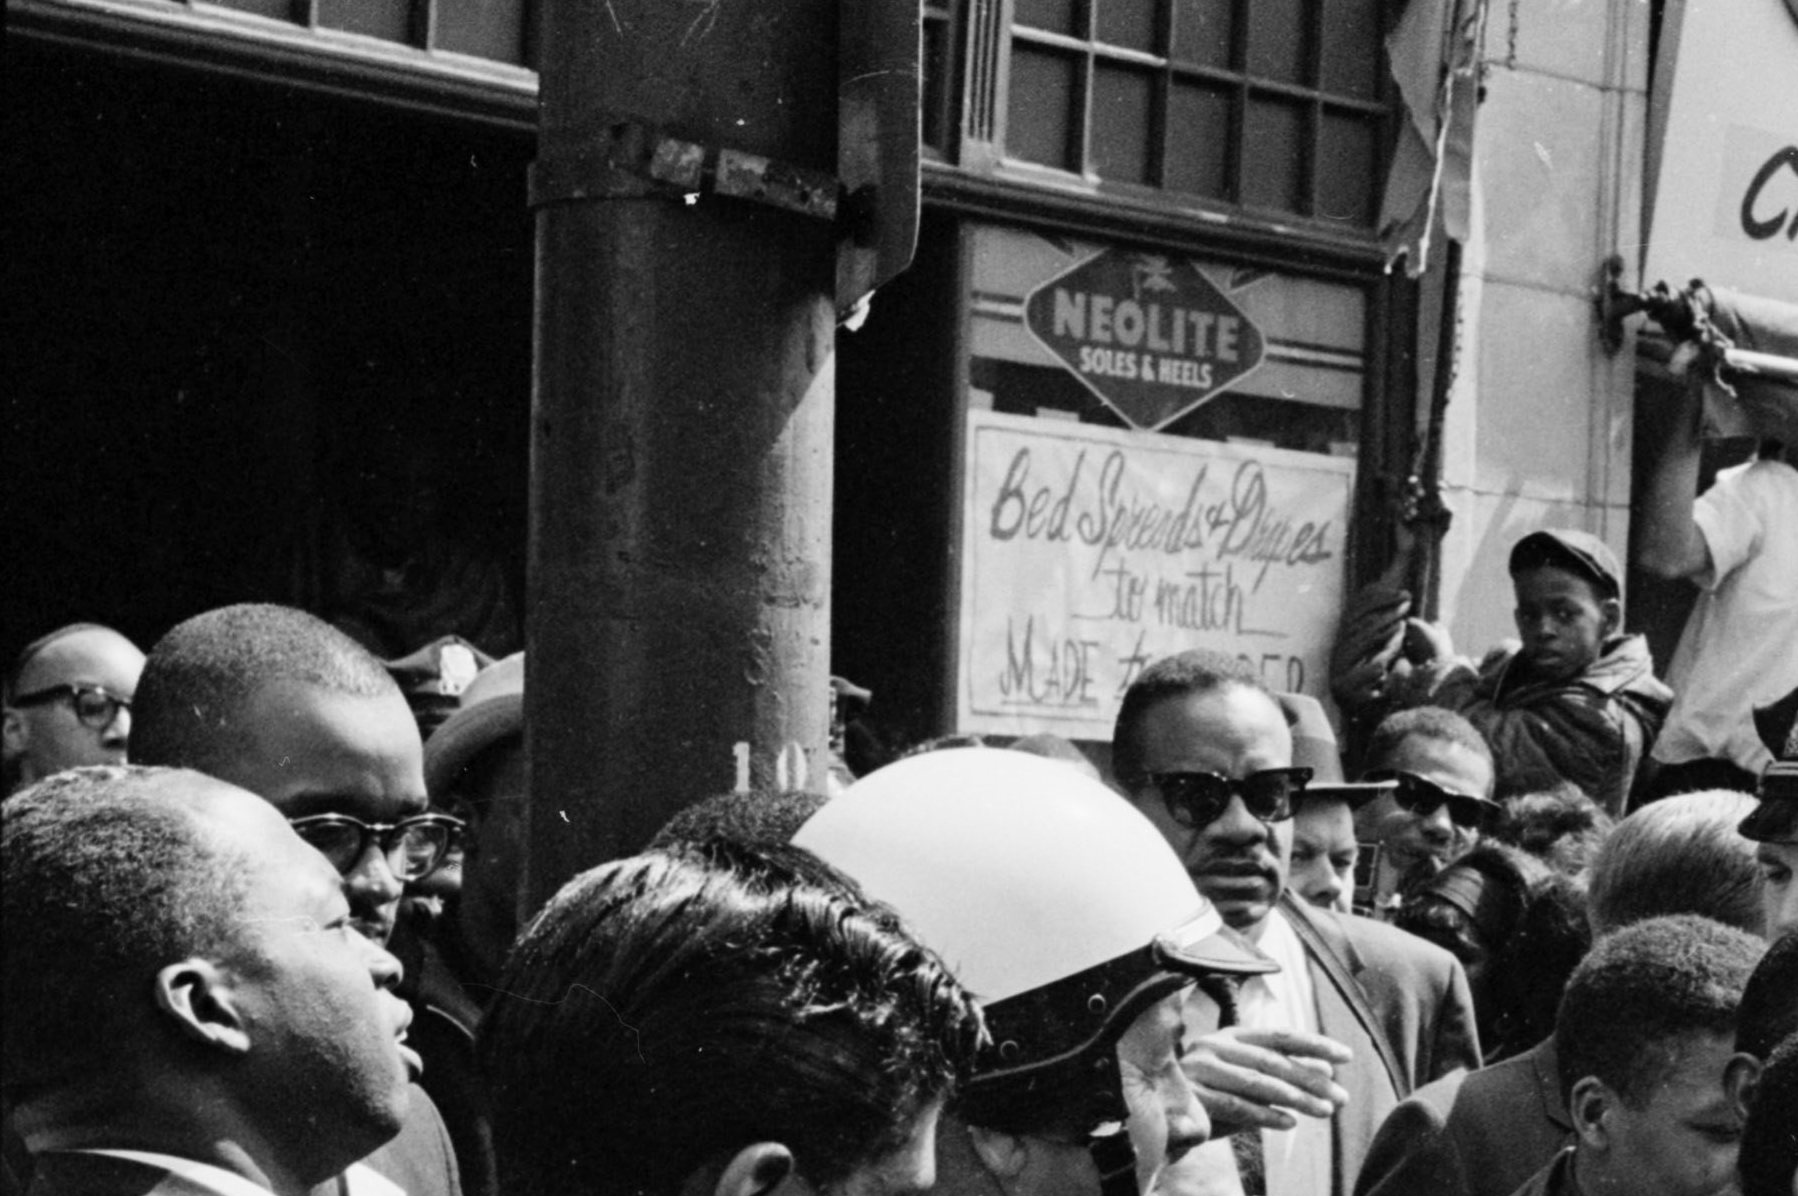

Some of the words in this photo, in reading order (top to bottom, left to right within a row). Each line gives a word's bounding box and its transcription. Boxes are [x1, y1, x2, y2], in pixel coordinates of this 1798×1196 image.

[1053, 288, 1239, 362] NEOLITE
[1079, 346, 1138, 379] SOLES
[1140, 352, 1156, 382] &
[1157, 358, 1213, 388] HEELS
[989, 447, 1086, 541] Bed
[1077, 449, 1203, 581] Spreads
[1205, 500, 1231, 537] &
[1098, 556, 1150, 622] to
[1153, 563, 1248, 635] match
[1000, 614, 1098, 702] MADE
